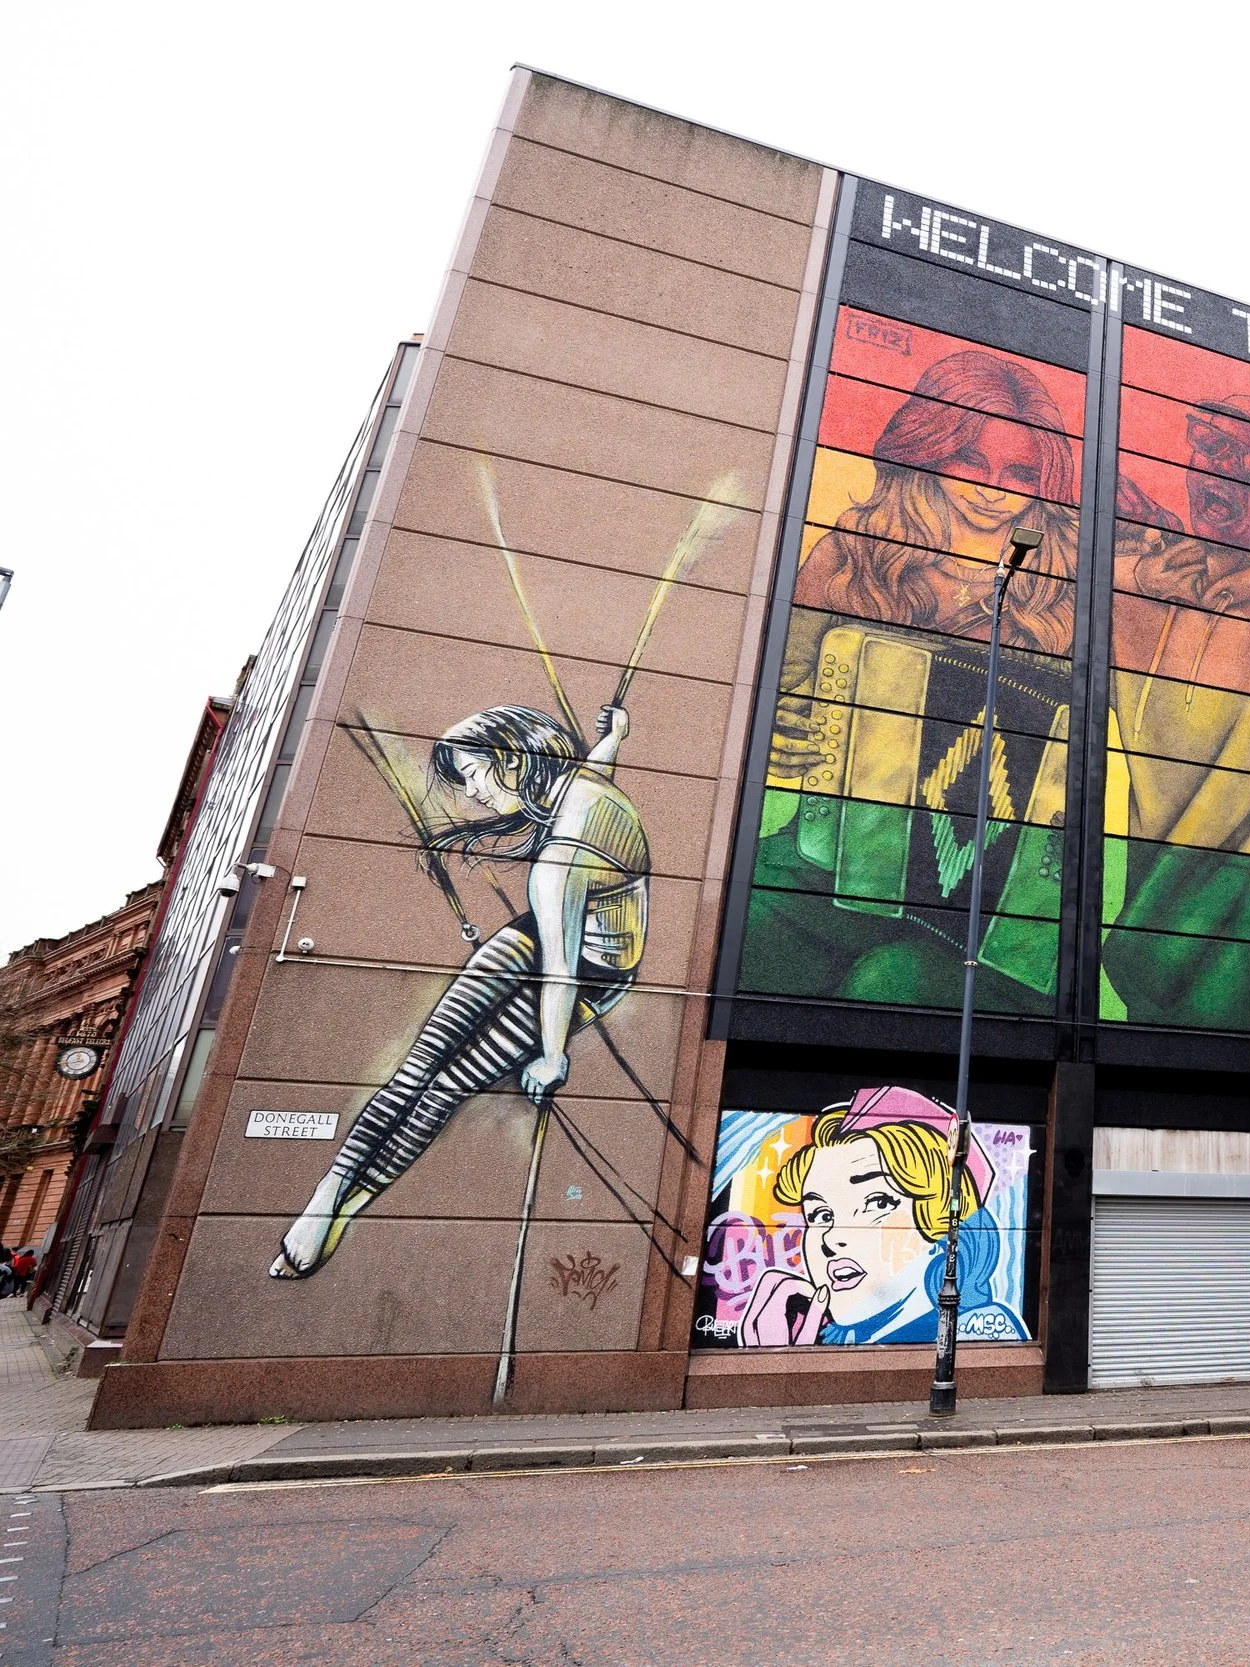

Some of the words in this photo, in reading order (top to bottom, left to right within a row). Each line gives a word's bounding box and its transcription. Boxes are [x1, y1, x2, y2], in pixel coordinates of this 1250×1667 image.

[881, 195, 1192, 334] WELCOME
[253, 1112, 333, 1126] DONEGALL
[263, 1125, 319, 1137] STREET
